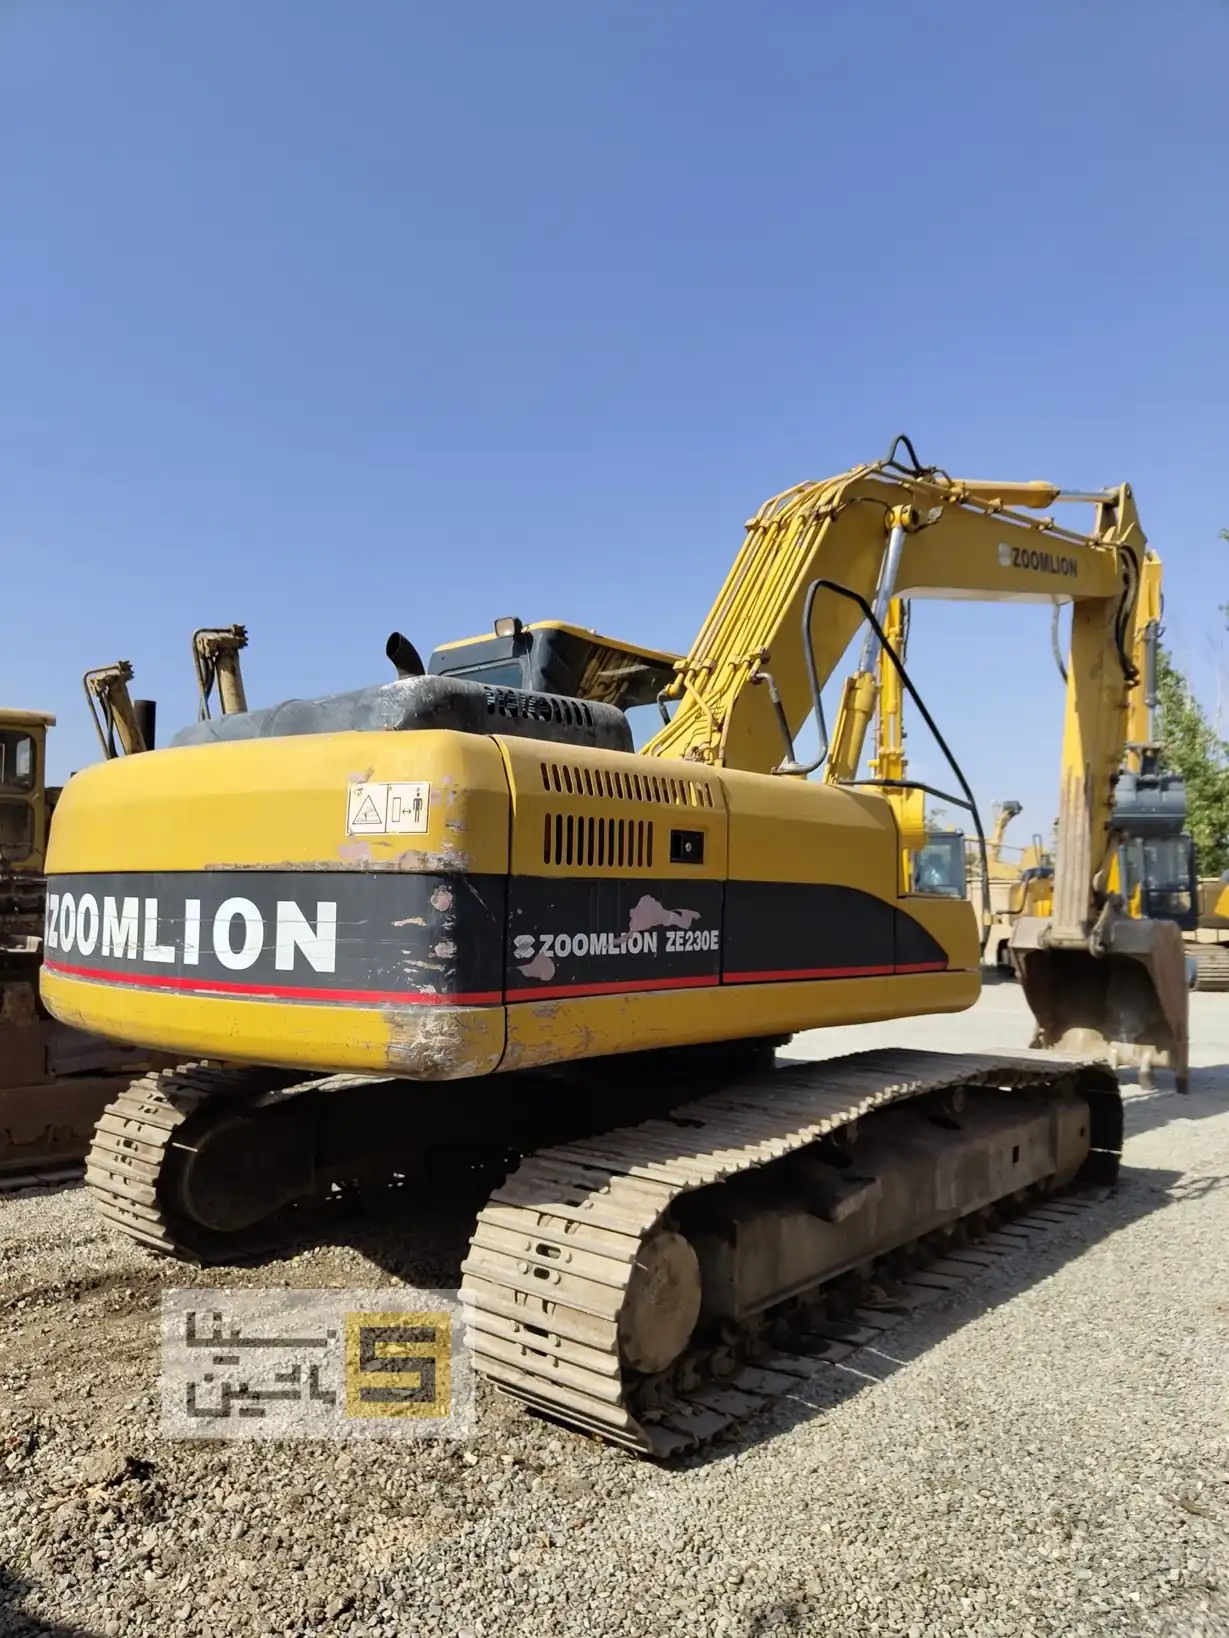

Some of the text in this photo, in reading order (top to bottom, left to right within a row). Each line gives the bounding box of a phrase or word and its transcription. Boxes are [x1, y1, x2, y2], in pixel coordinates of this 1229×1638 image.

[1011, 546, 1078, 577] ZOOMLION
[48, 891, 338, 973] ZOOMLION
[539, 929, 720, 958] ZOOMLION ZE230E
